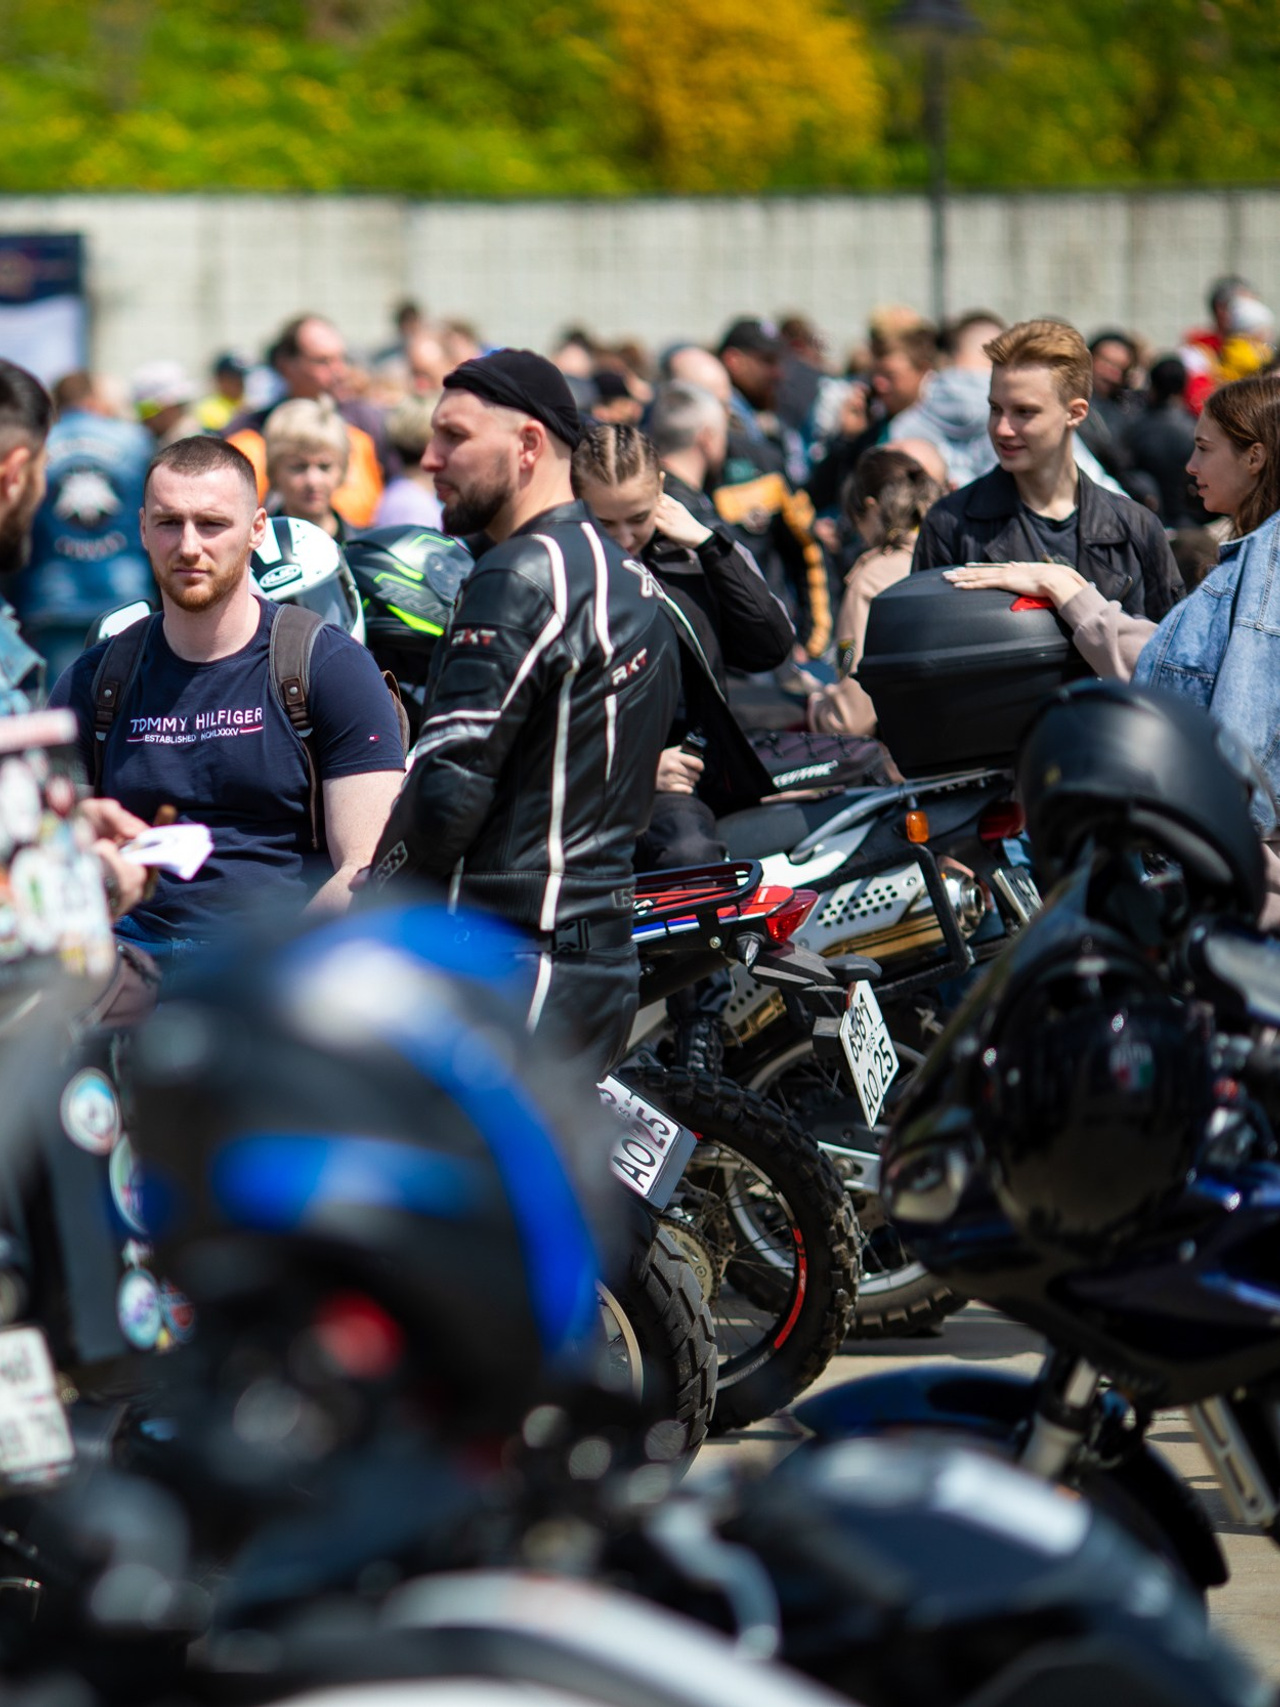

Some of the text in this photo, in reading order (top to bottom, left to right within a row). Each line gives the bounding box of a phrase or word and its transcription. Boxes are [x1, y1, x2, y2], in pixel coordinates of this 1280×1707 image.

[130, 707, 263, 733] TOMMY HILFIGER
[144, 734, 196, 744] ESTABLISHED
[874, 1036, 894, 1087] 25
[612, 1106, 671, 1188] AO 25
